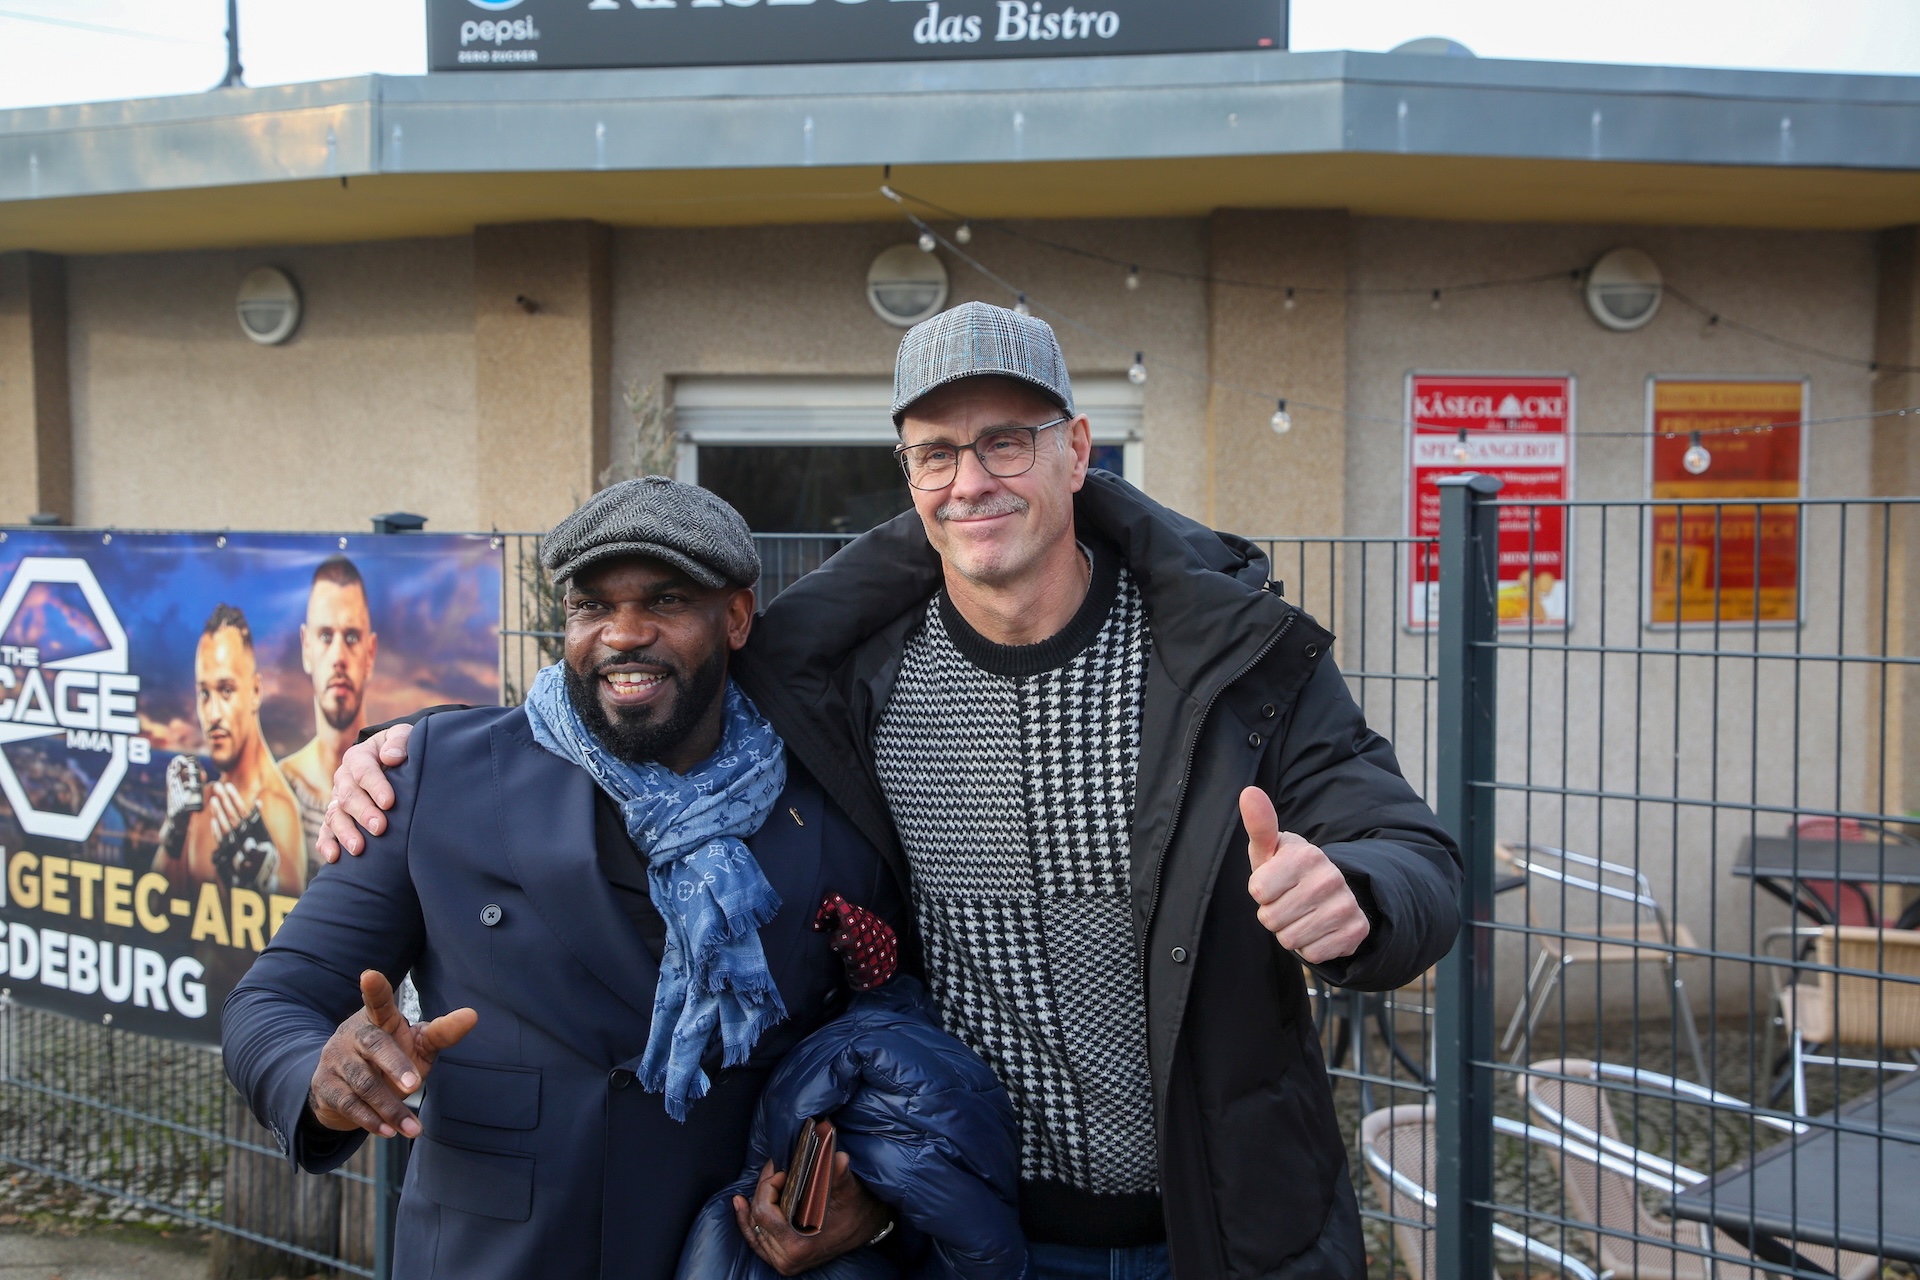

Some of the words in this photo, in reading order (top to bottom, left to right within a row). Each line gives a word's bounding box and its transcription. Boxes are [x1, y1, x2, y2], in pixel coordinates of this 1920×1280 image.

[461, 15, 533, 46] pepsi
[913, 2, 981, 44] das
[995, 0, 1120, 41] Bistro
[458, 50, 490, 63] ZERO
[0, 645, 40, 667] THE
[66, 729, 112, 753] MMA
[128, 737, 151, 765] 8
